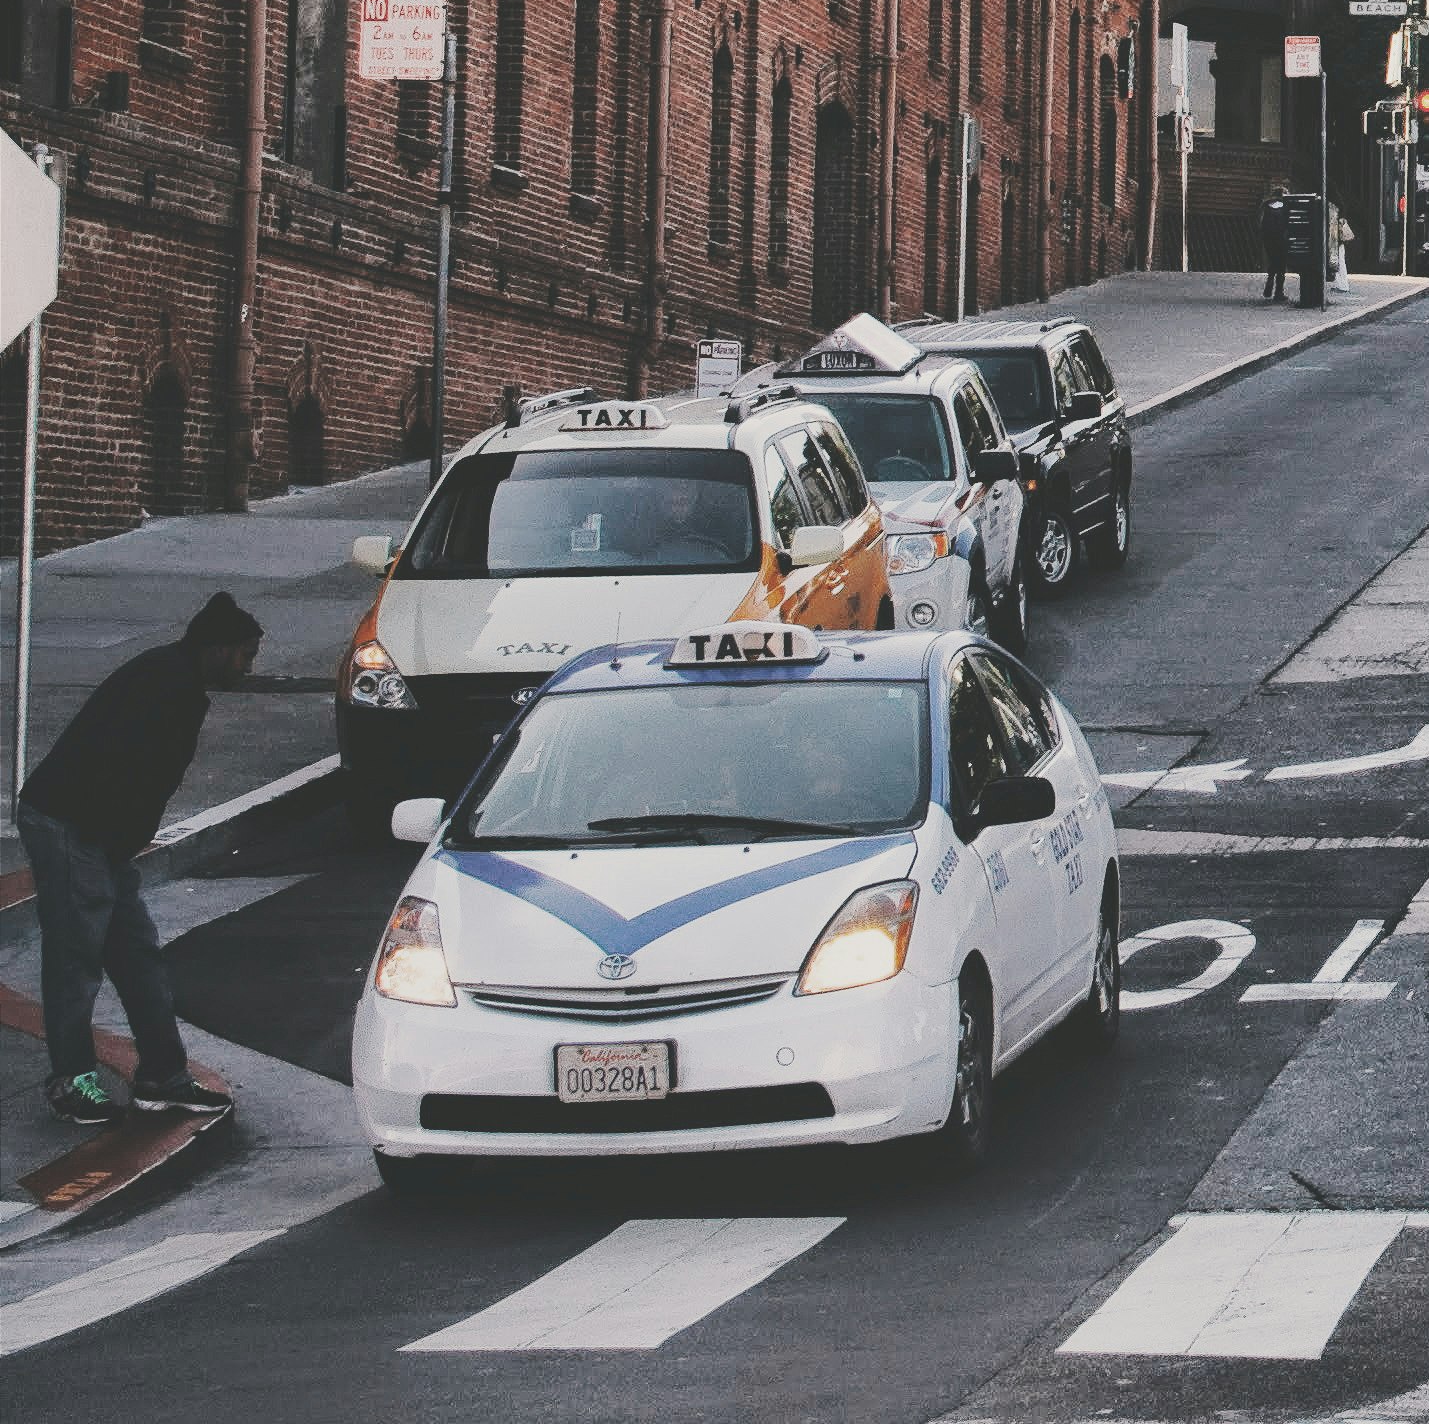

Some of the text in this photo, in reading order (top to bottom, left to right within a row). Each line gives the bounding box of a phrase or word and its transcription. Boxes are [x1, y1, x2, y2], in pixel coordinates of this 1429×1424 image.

[366, 0, 441, 20] NO PARKING
[1355, 4, 1401, 13] BEACH
[371, 47, 434, 61] TUES THURS
[577, 409, 647, 427] TAXI
[496, 642, 573, 657] TAXI
[689, 631, 794, 661] TAXI
[581, 1049, 642, 1065] California
[566, 1066, 661, 1094] 00328A1
